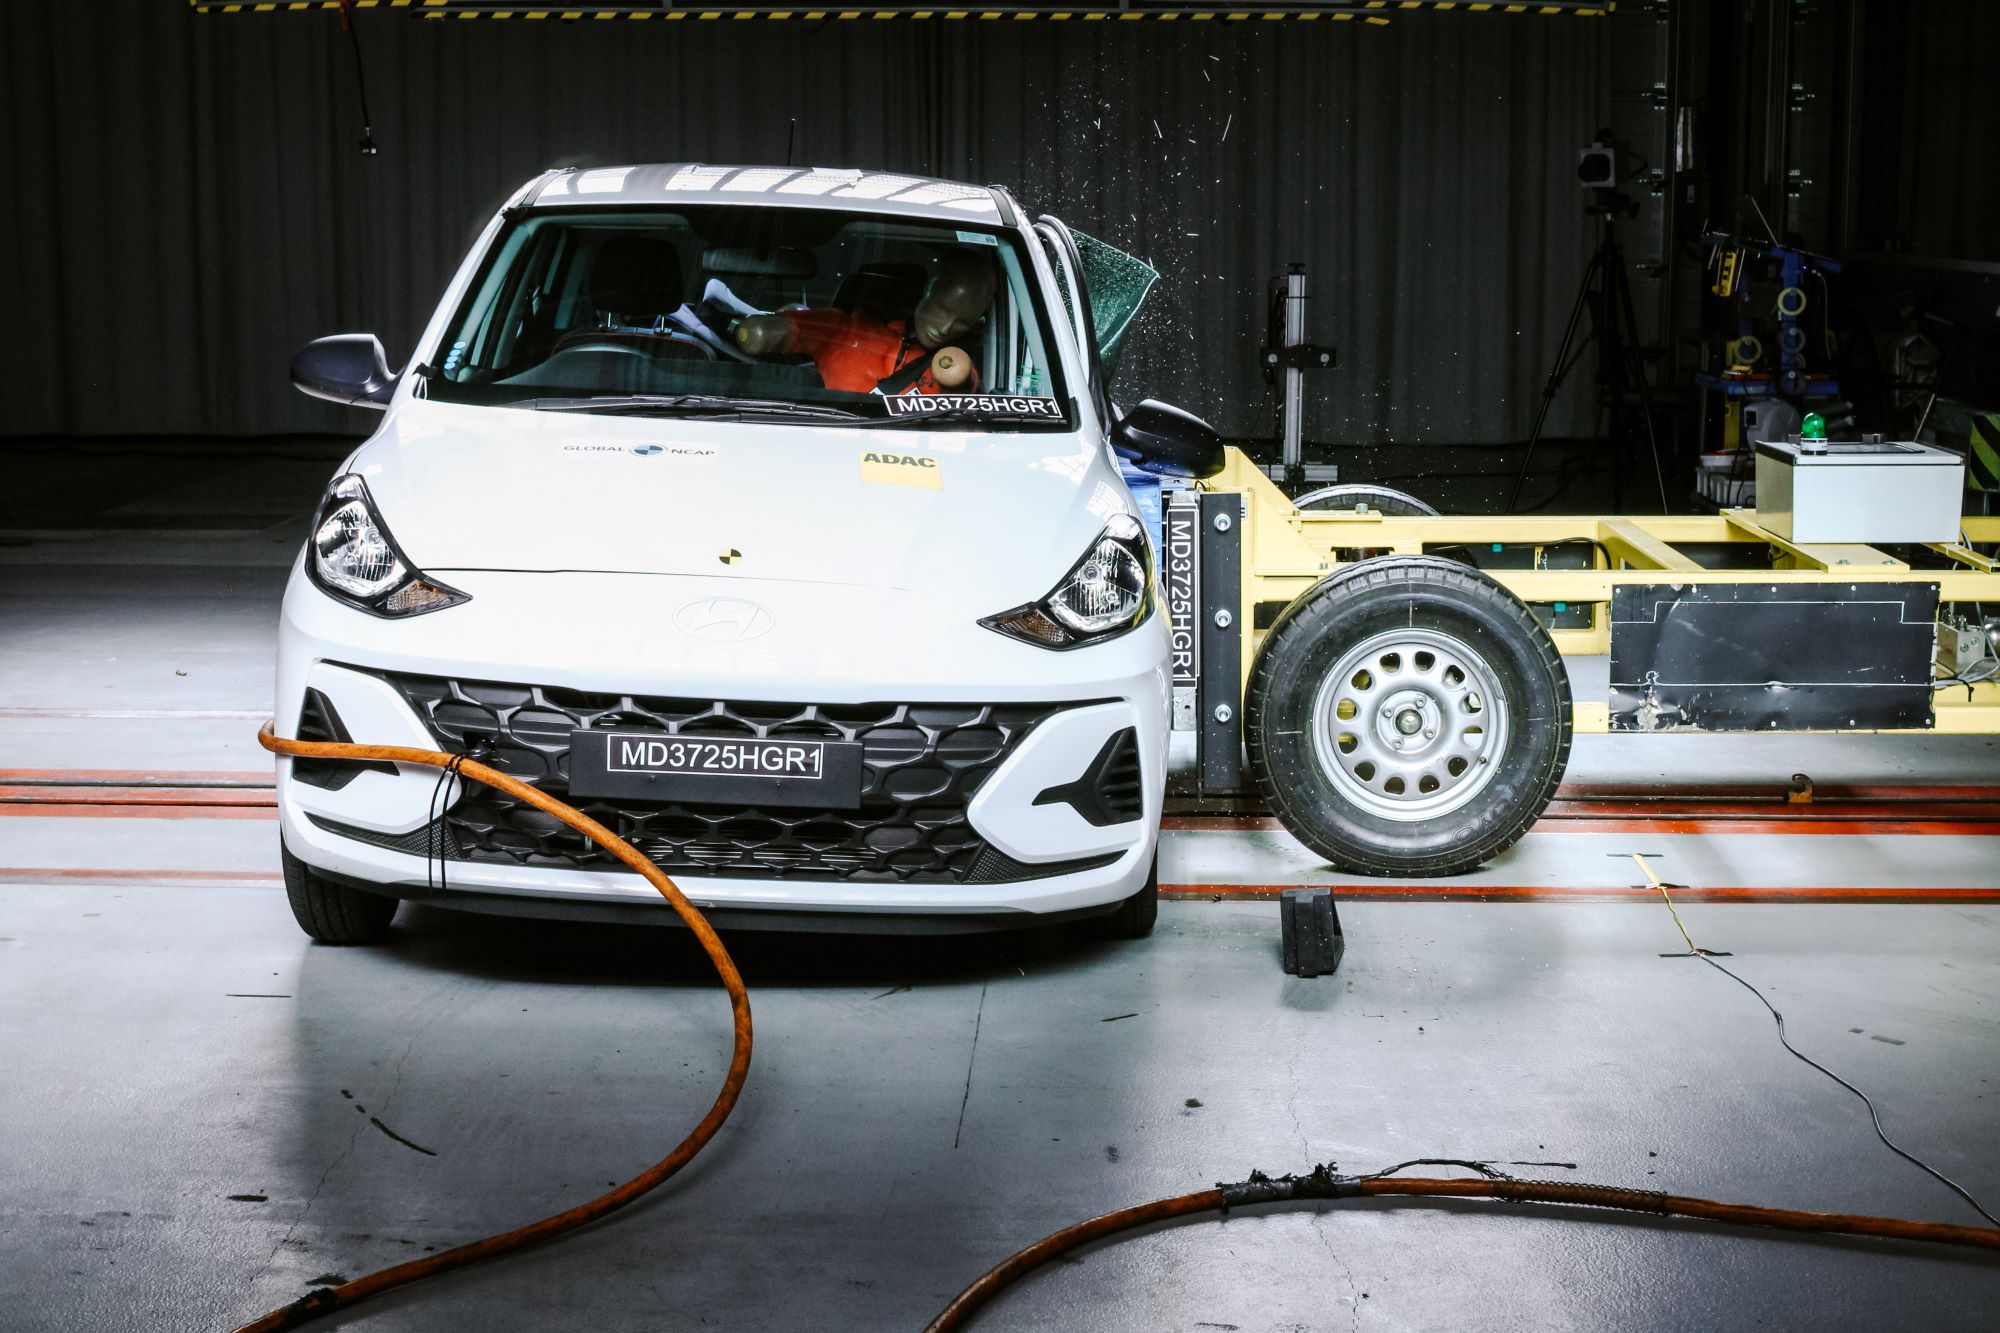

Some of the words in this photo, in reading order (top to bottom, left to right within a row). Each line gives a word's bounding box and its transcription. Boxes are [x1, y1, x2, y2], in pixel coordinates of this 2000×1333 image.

[897, 397, 1059, 414] MD3725HGR1
[863, 453, 936, 468] ADAC
[1171, 520, 1192, 680] MD3725HGR1
[622, 741, 821, 772] MD3725HGR1
